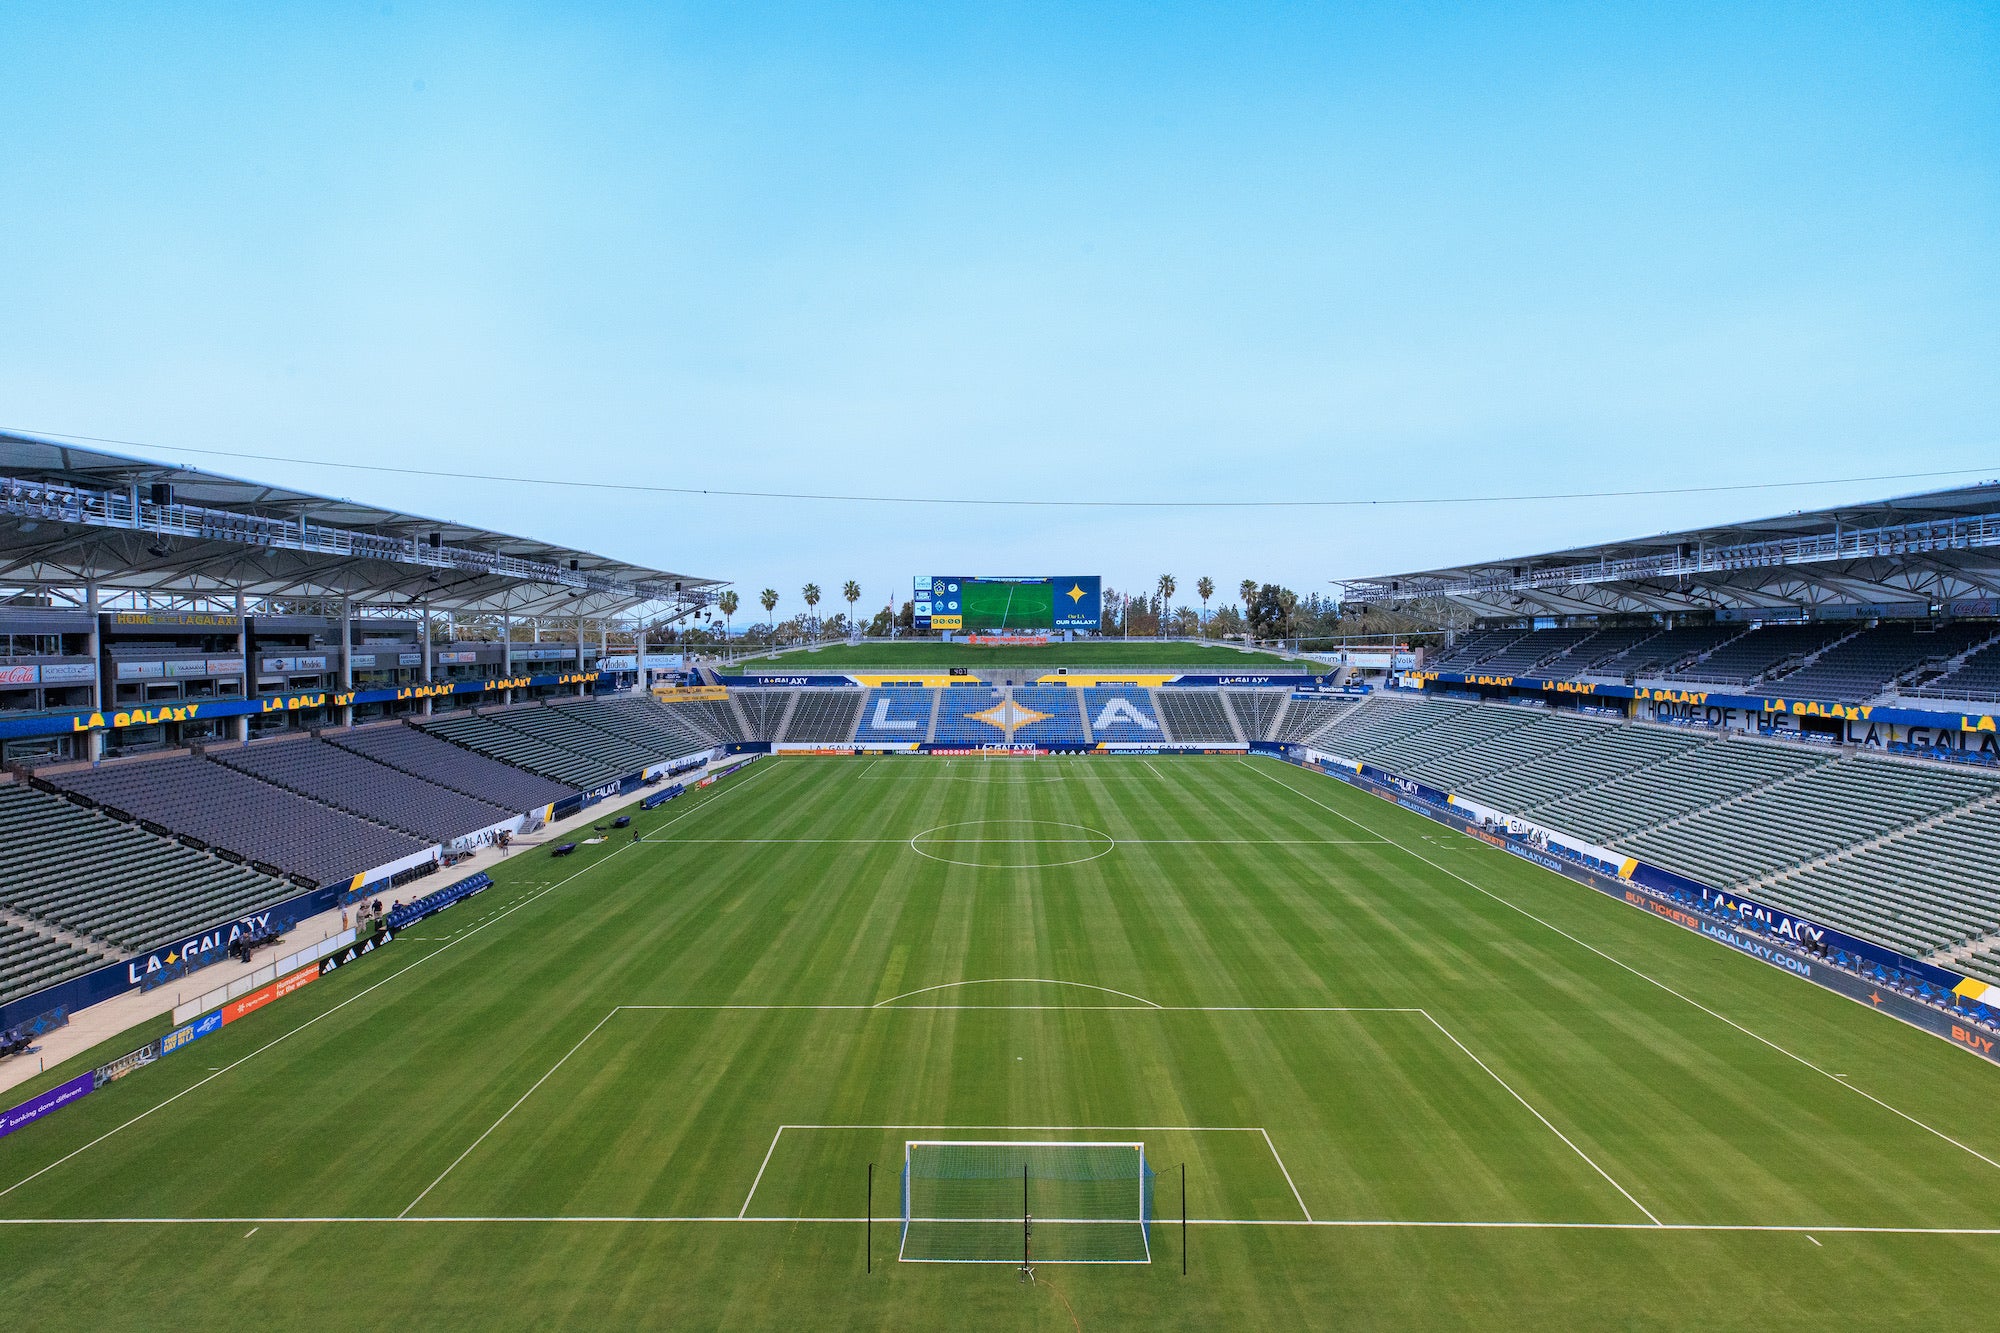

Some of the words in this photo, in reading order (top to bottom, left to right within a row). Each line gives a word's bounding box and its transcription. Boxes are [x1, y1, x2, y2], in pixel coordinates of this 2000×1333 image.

[302, 660, 321, 668] Modelo
[607, 658, 628, 669] Modelo
[485, 679, 496, 691] LA
[497, 676, 531, 690] GALAXY
[559, 674, 570, 684] LA
[571, 672, 600, 683] GALAXY
[1219, 676, 1230, 685] LA
[1235, 677, 1269, 685] GALAXY
[1411, 671, 1439, 681] GALAXY
[1465, 675, 1476, 684] LA
[1478, 676, 1513, 687] GALAXY
[398, 685, 412, 700] LA
[415, 683, 455, 698] GALAXY
[1319, 685, 1344, 693] Spectrum
[1542, 680, 1554, 691] LA
[1557, 681, 1596, 695] GALAXY
[263, 697, 283, 712] LA
[1634, 688, 1650, 699] LA
[1654, 690, 1708, 705] GALAXY
[74, 712, 105, 731] LA
[114, 705, 199, 727] GALAXY
[1764, 699, 1786, 713] LA
[1793, 701, 1873, 720] GALAXY
[1648, 701, 1701, 719] HOME
[1705, 704, 1737, 726] OF
[1745, 709, 1789, 729] THE
[1848, 721, 1881, 747] LA
[1961, 714, 1996, 732] LA
[595, 780, 621, 797] GALAXY
[1394, 777, 1419, 795] GALAXY
[1397, 797, 1432, 817] LAGALAXY.COM
[1493, 813, 1504, 826] LA
[1466, 825, 1477, 836] BUY
[1479, 831, 1506, 848] TICKETS!
[1507, 842, 1562, 872] LAGALAXY.COM
[1702, 888, 1726, 907] LA
[1625, 891, 1646, 906] BUY
[1650, 901, 1699, 929] TICKETS!
[1701, 922, 1811, 977] LAGALAXY.COM
[128, 955, 163, 984] LA
[276, 965, 320, 990] Humankindness
[276, 987, 285, 999] for
[286, 984, 296, 994] the
[296, 978, 308, 989] win.
[164, 1034, 177, 1045] THE
[1951, 1025, 1995, 1054] BUY
[9, 1109, 37, 1128] banking
[38, 1100, 55, 1114] done
[55, 1086, 83, 1104] different
